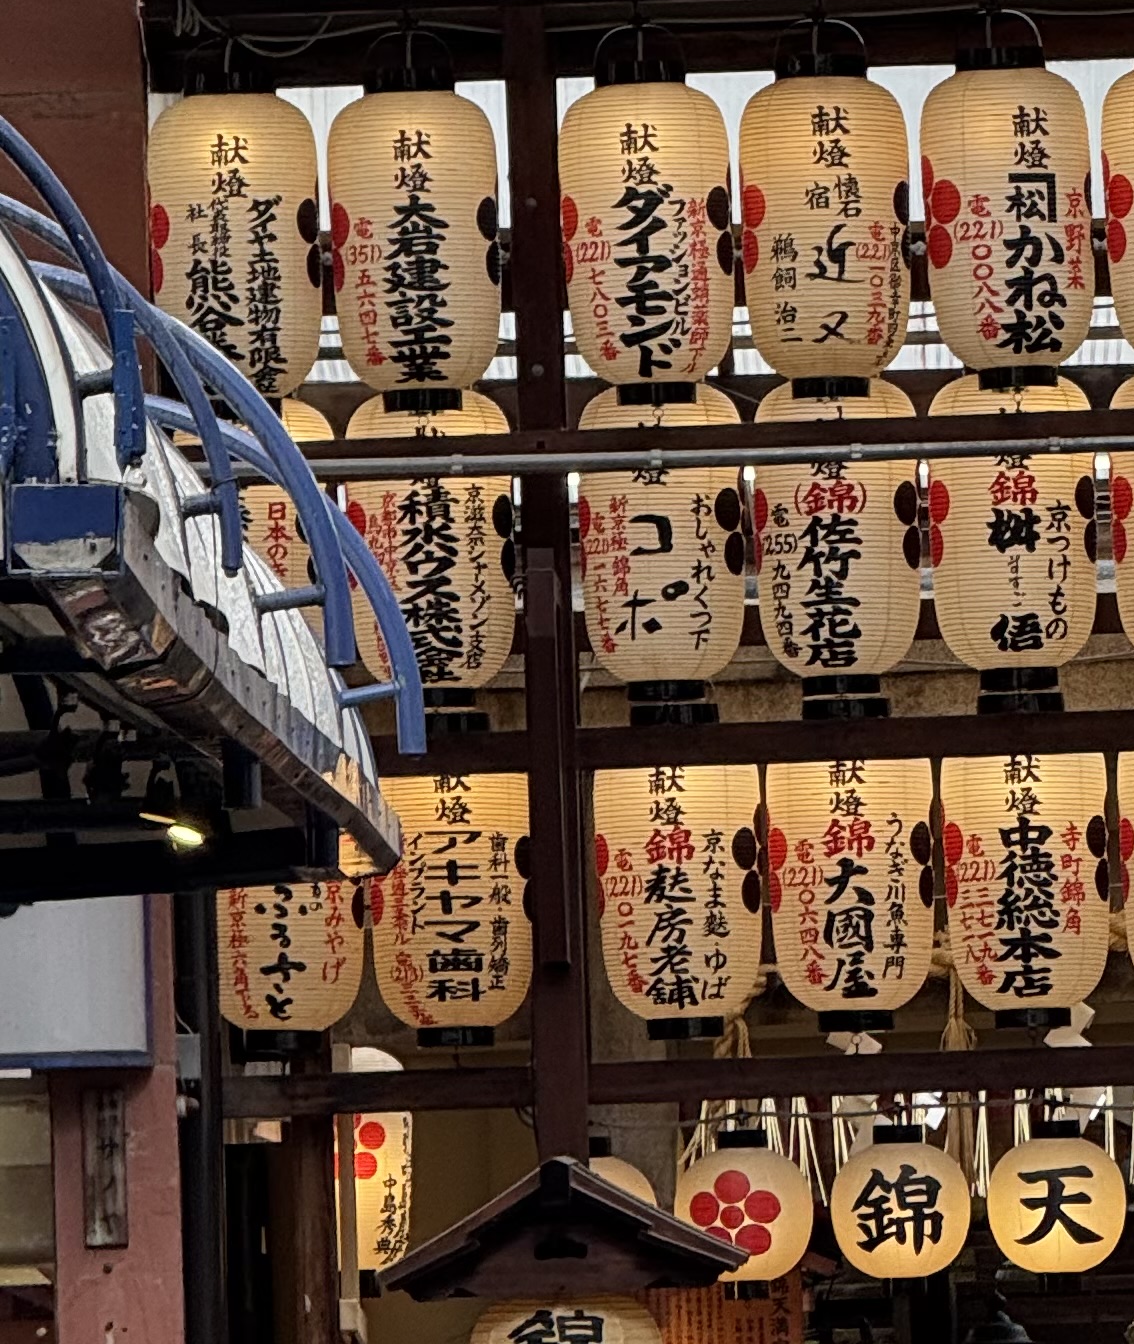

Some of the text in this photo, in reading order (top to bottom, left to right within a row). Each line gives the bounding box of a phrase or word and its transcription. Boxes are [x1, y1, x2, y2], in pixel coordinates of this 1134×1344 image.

[210, 133, 250, 198] 献燈
[810, 105, 851, 169] 献燈
[1012, 105, 1051, 170] 献燈
[186, 203, 208, 256] 社長
[804, 181, 830, 211] 宿
[1064, 187, 1085, 290] 京野菜
[382, 129, 455, 384] 献燈 大岩建設工業
[611, 123, 681, 378] 献燈 ダイアモンド
[667, 198, 691, 337] ファッションビル
[804, 223, 865, 344] 近又
[996, 224, 1067, 355] かね松
[797, 513, 863, 668] 佐竹生花店
[1045, 500, 1072, 641] 京つけもの
[648, 767, 686, 826] 献燈
[828, 760, 868, 817] 献燈
[1004, 755, 1042, 816] 献燈
[407, 832, 426, 936] インプラント
[424, 775, 486, 1002] 献燈 アキヤマ歯科
[823, 857, 878, 999] 大國屋
[1060, 820, 1086, 936] 寺町錦角
[322, 881, 346, 984] 京みやげ
